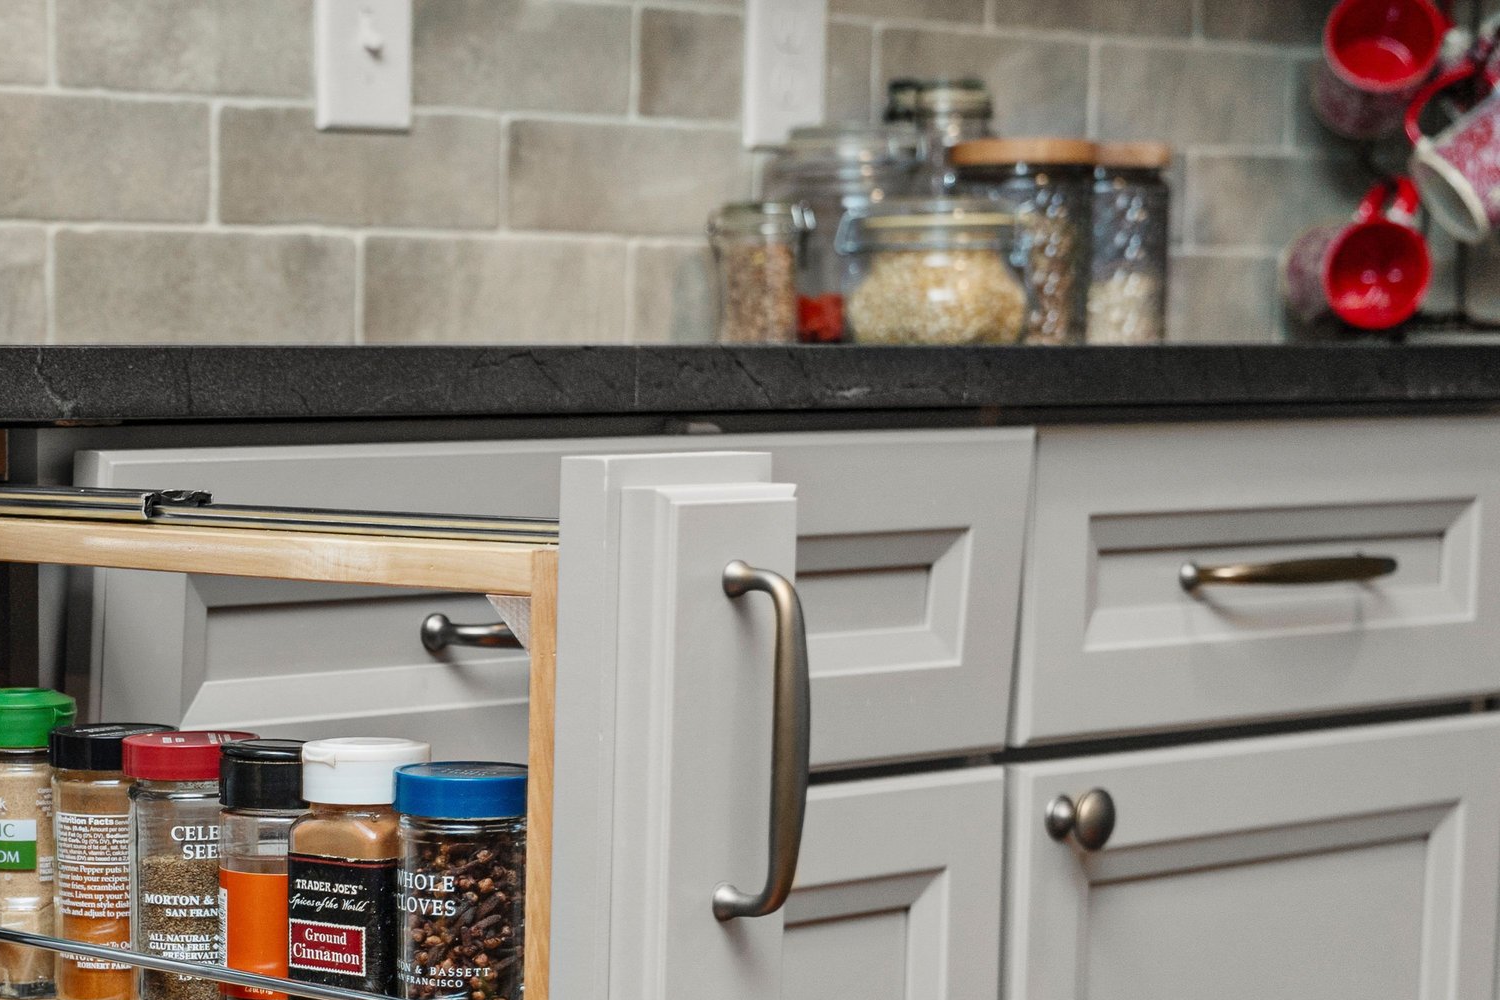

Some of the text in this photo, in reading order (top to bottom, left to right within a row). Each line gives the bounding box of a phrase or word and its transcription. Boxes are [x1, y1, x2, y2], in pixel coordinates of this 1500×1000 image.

[89, 817, 114, 826] Facts
[171, 825, 220, 841] CELE
[183, 844, 221, 860] SEE
[80, 866, 122, 876] Pepper puts
[87, 883, 125, 891] scrambled
[295, 879, 358, 895] TRADER JOE'S
[75, 891, 93, 899] Liven
[94, 893, 103, 901] up
[144, 893, 214, 905] MORTON &
[97, 899, 114, 909] style
[289, 893, 370, 912] Spices of the World
[84, 909, 105, 918] adjust
[107, 909, 114, 917] to
[165, 908, 218, 917] SAN FRAN
[150, 934, 211, 942] ALL NATURAL
[305, 928, 347, 945] Ground
[150, 942, 185, 950] GLUTEN
[162, 951, 219, 960] PRESERVATI
[292, 942, 360, 965] Cinnamon
[415, 965, 491, 977] & BASSETT
[406, 975, 464, 988] FRANCISCO
